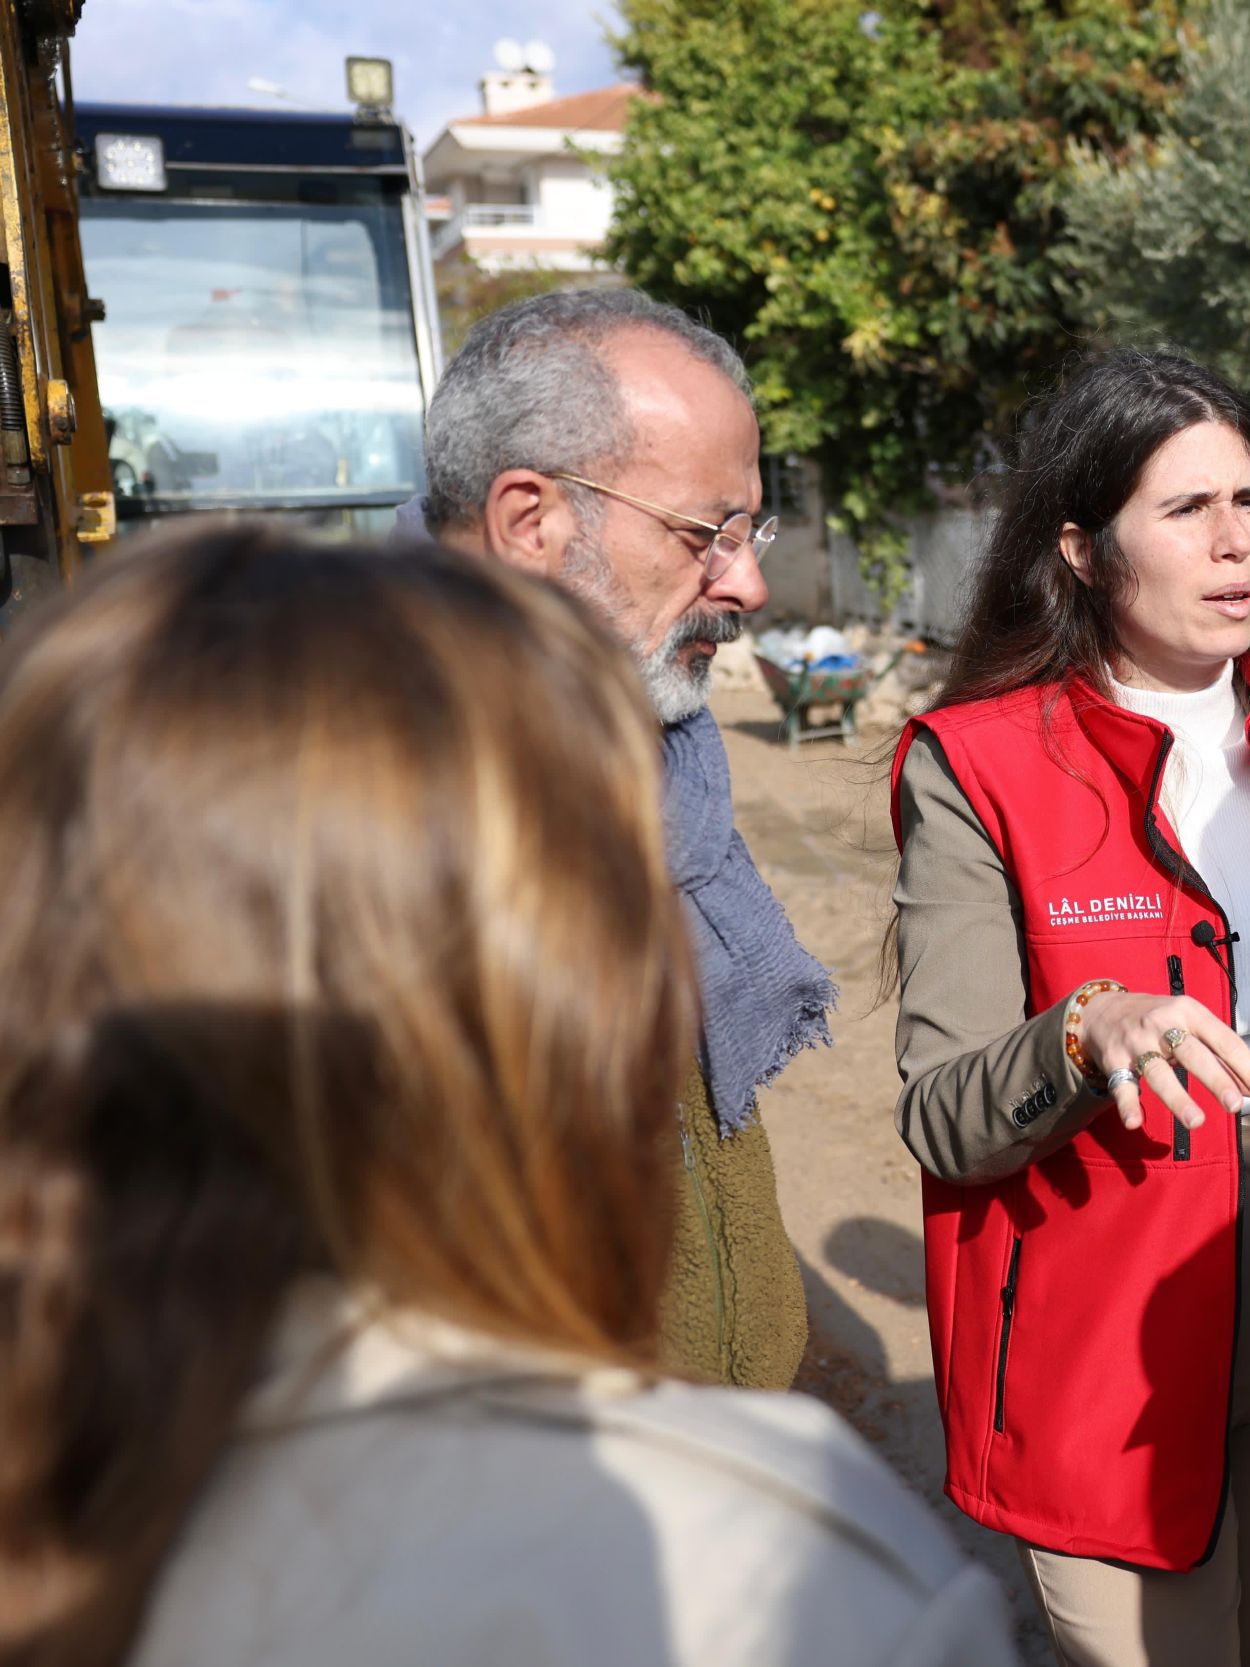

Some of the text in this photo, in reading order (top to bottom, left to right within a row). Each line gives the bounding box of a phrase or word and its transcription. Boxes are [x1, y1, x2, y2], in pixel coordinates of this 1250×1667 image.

[1049, 893, 1161, 914] LÂL DENİZLİ
[1050, 911, 1163, 926] ÇEŞME BELEDİYE BAŞKANI
